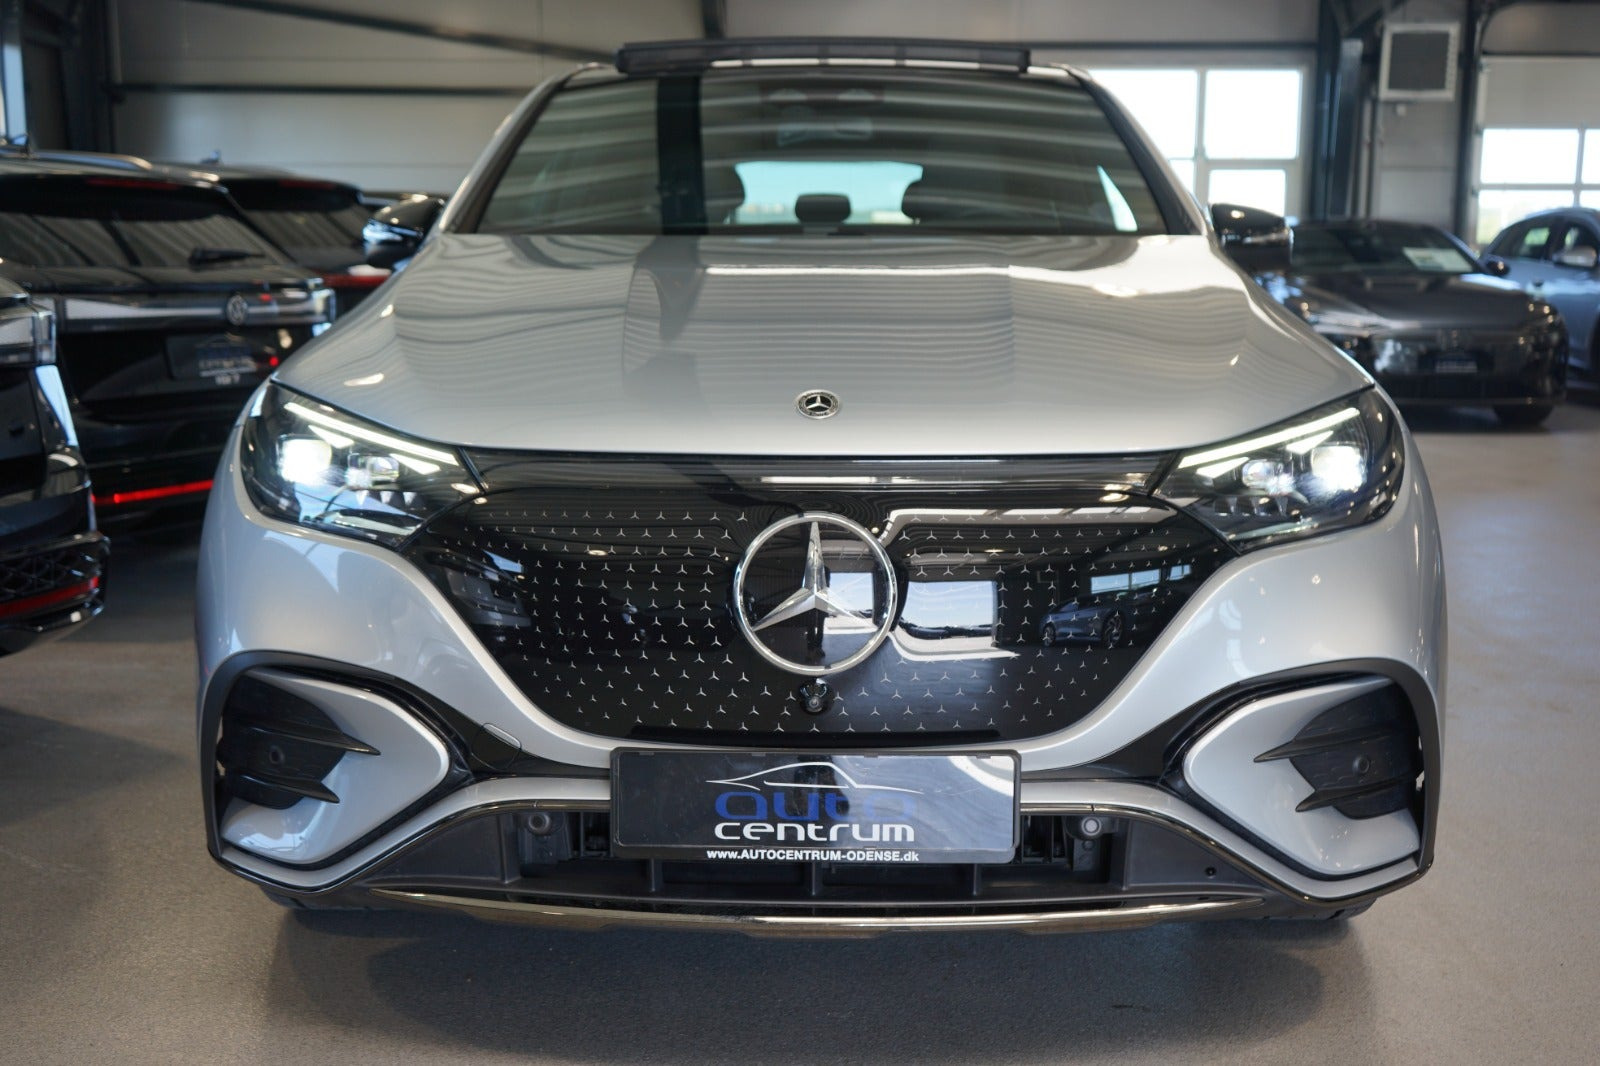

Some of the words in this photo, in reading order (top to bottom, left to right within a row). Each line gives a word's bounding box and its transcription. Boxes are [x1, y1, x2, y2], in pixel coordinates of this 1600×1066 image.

[715, 792, 914, 821] auto
[714, 822, 914, 841] centrum
[706, 849, 919, 861] www.AUTOCENTRUM-ODENSE.dk
